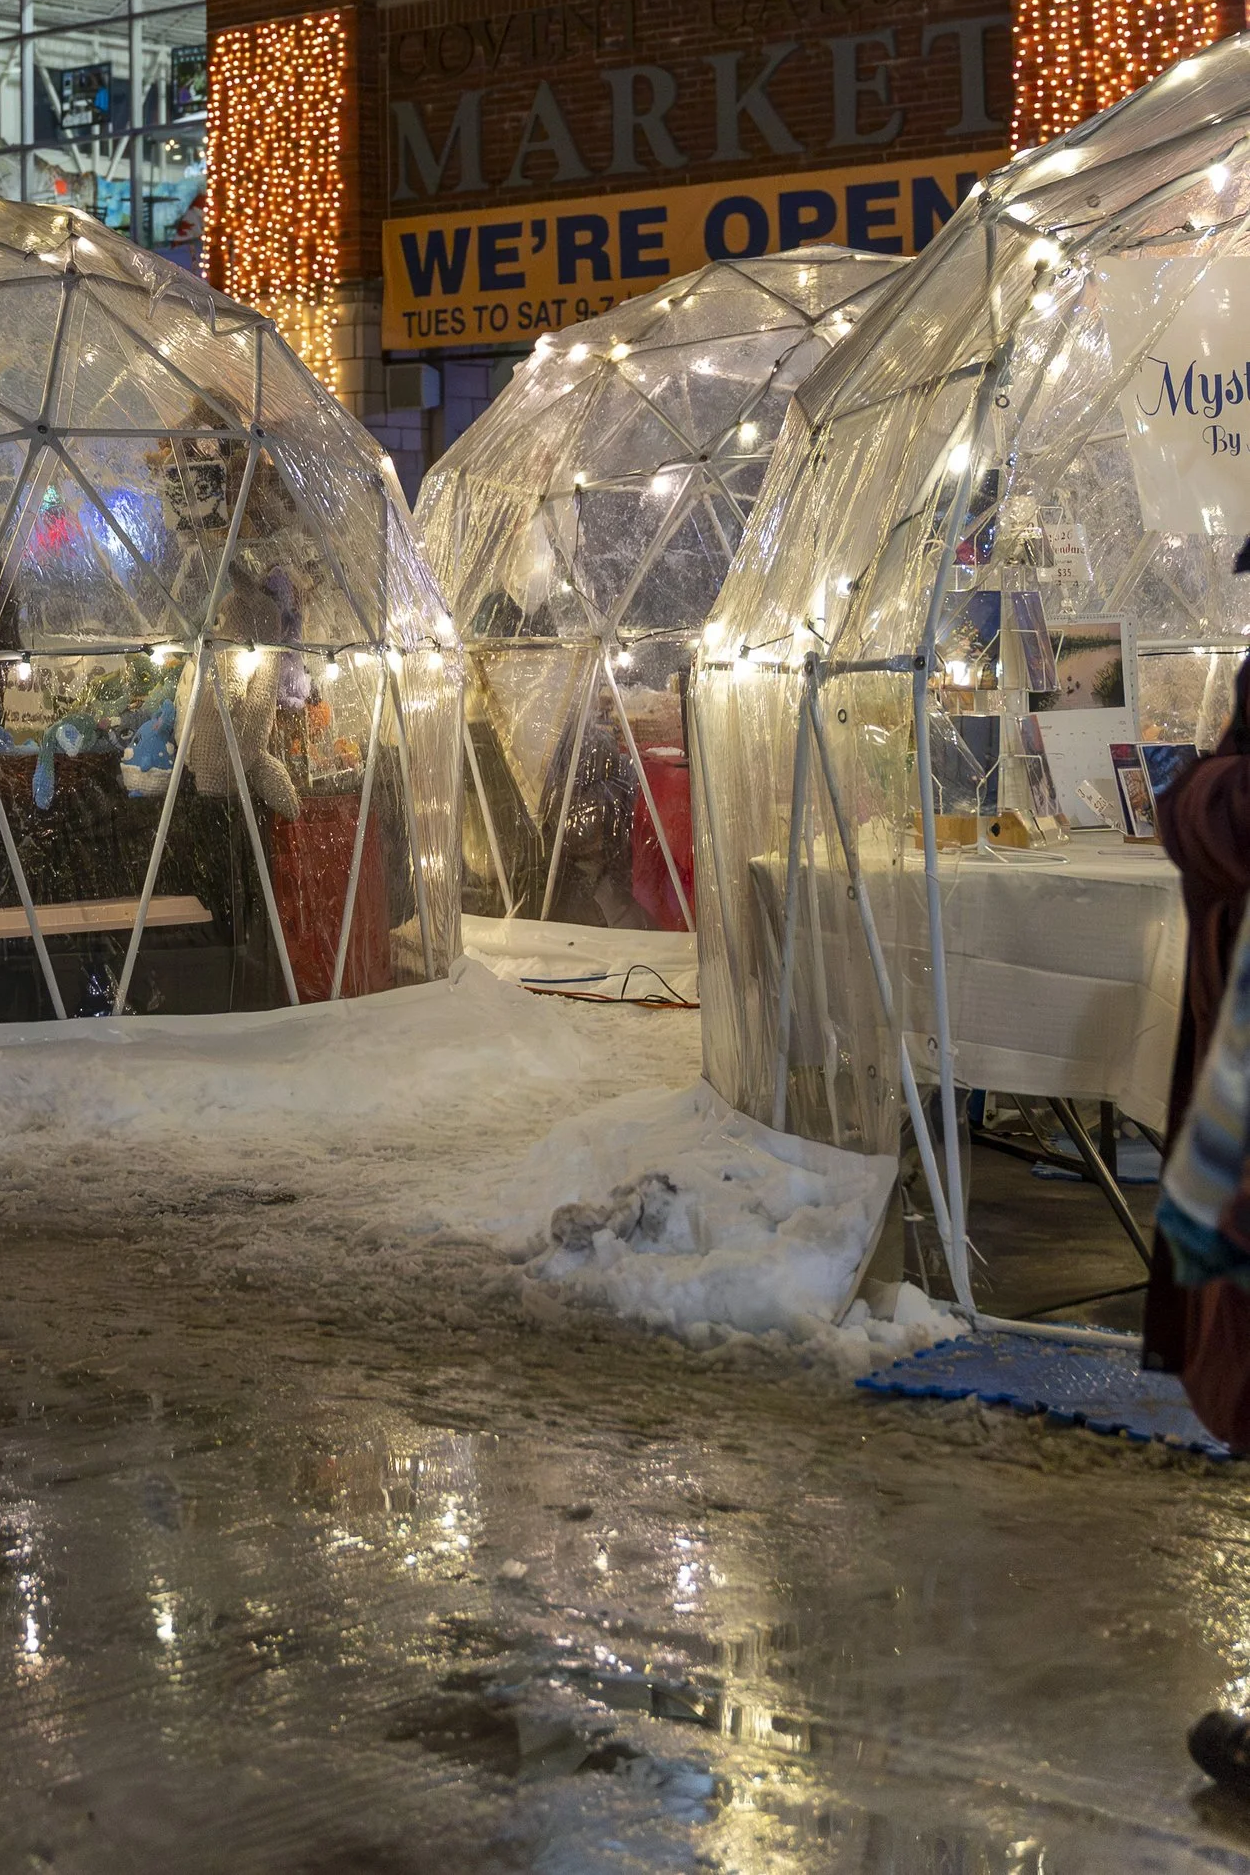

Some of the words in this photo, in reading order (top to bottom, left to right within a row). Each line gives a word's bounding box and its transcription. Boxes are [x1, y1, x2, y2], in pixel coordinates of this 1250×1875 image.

[389, 14, 1014, 203] MARKET
[399, 206, 671, 298] WE'RE
[704, 171, 979, 260] OPEN
[402, 307, 467, 339] TUES
[473, 303, 510, 334] TO
[517, 297, 569, 330] SAT
[1202, 424, 1242, 457] By
[1057, 567, 1072, 578] $35
